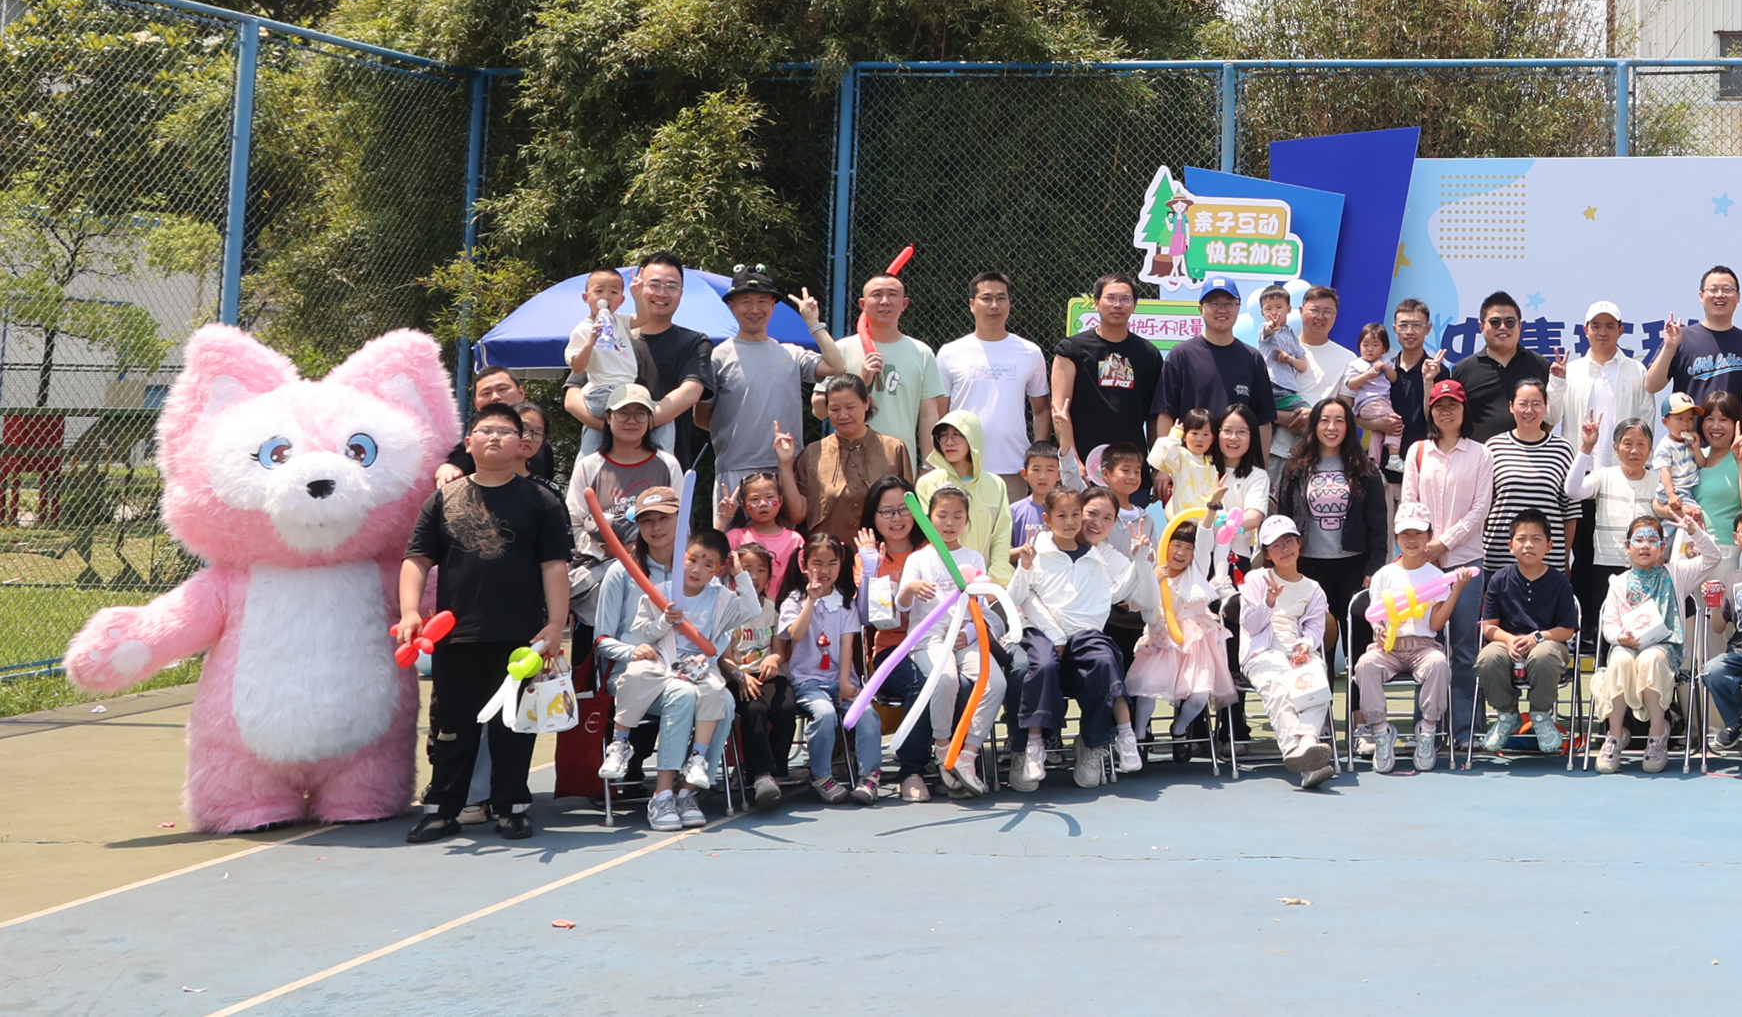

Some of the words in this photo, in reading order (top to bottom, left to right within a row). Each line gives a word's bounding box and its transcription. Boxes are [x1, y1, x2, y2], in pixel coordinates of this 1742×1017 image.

[1193, 211, 1279, 236] 亲子互动
[1206, 240, 1293, 267] 快乐加倍
